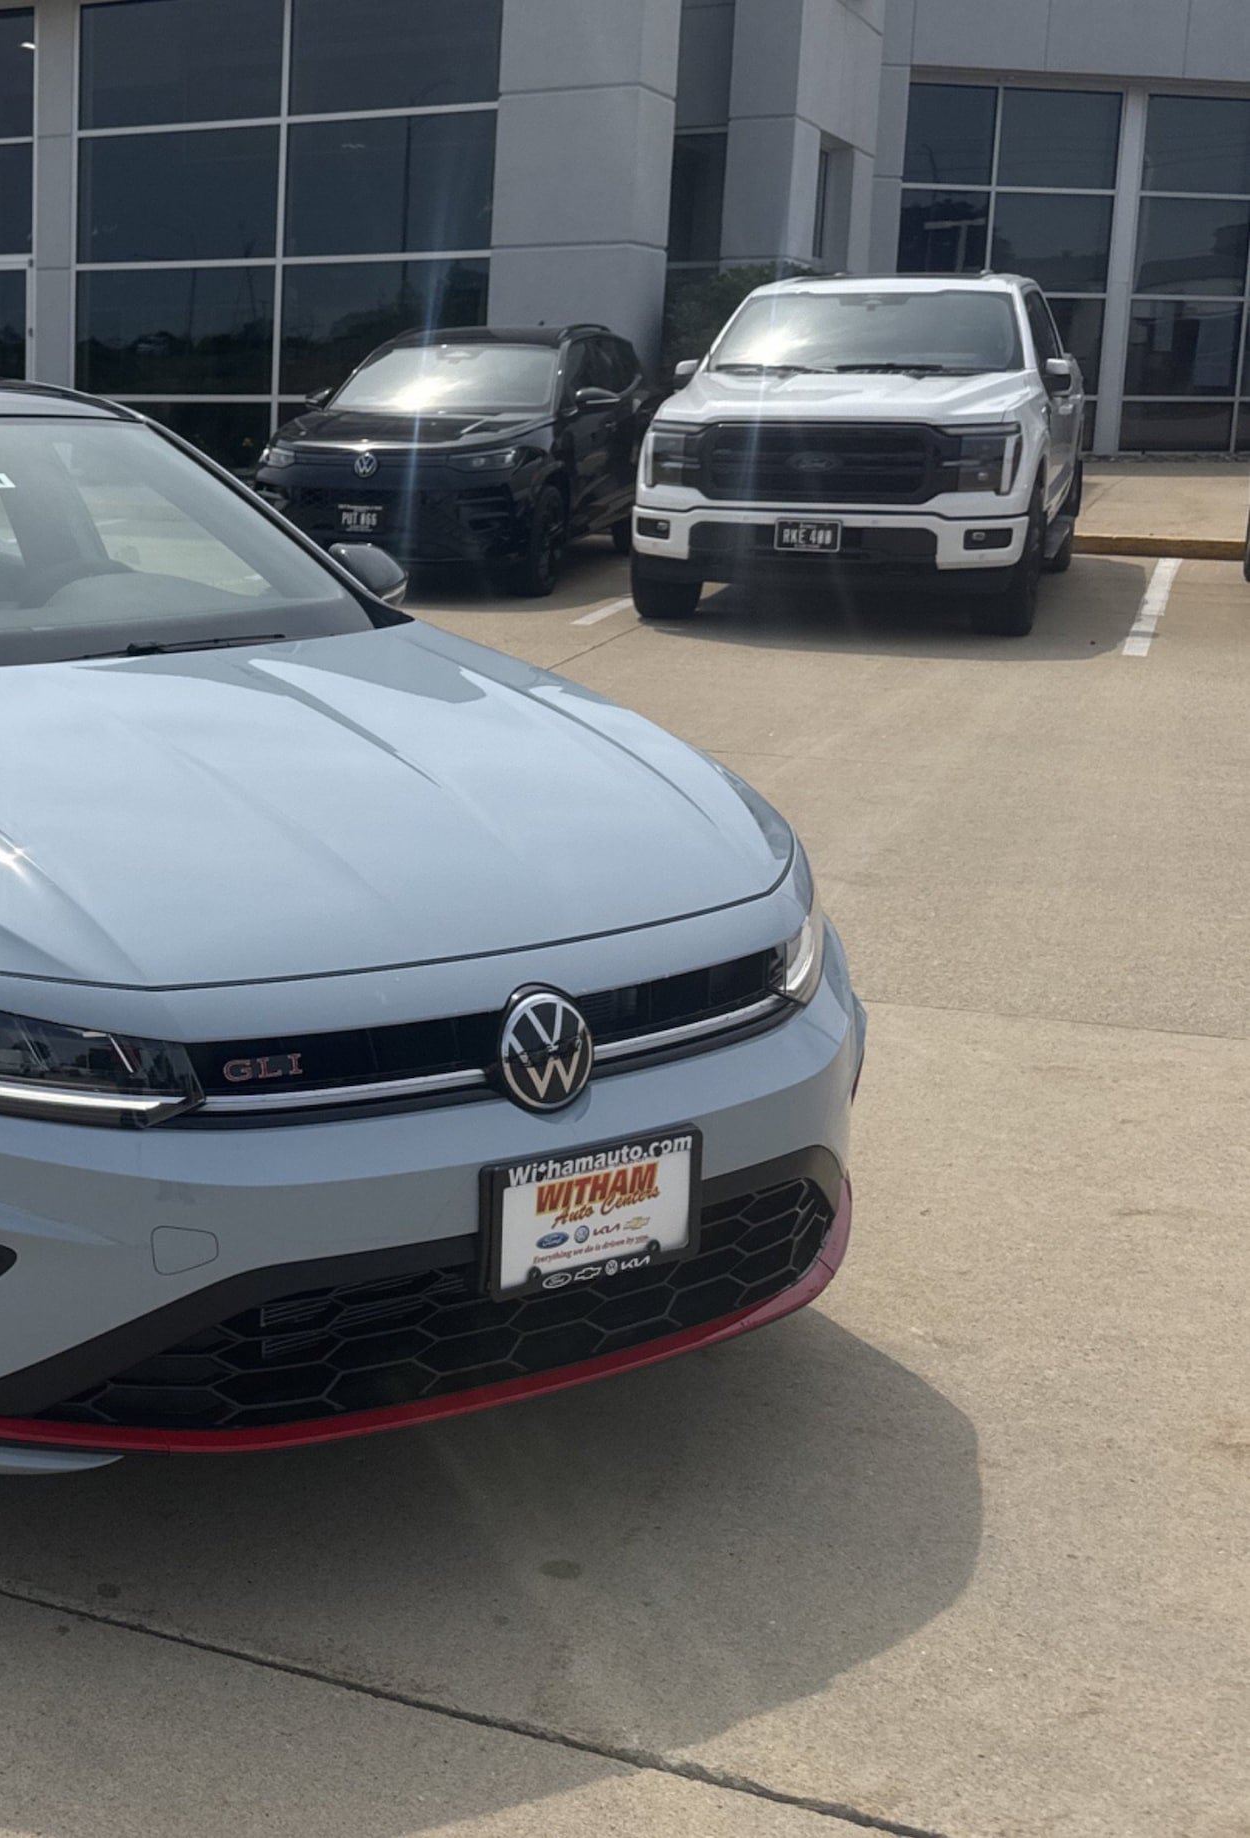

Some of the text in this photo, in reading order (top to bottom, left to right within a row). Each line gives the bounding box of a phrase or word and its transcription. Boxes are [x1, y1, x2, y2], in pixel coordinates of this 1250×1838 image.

[223, 1053, 303, 1082] GLI
[536, 1162, 659, 1215] WITHAM
[551, 1185, 661, 1229] Auto Centers
